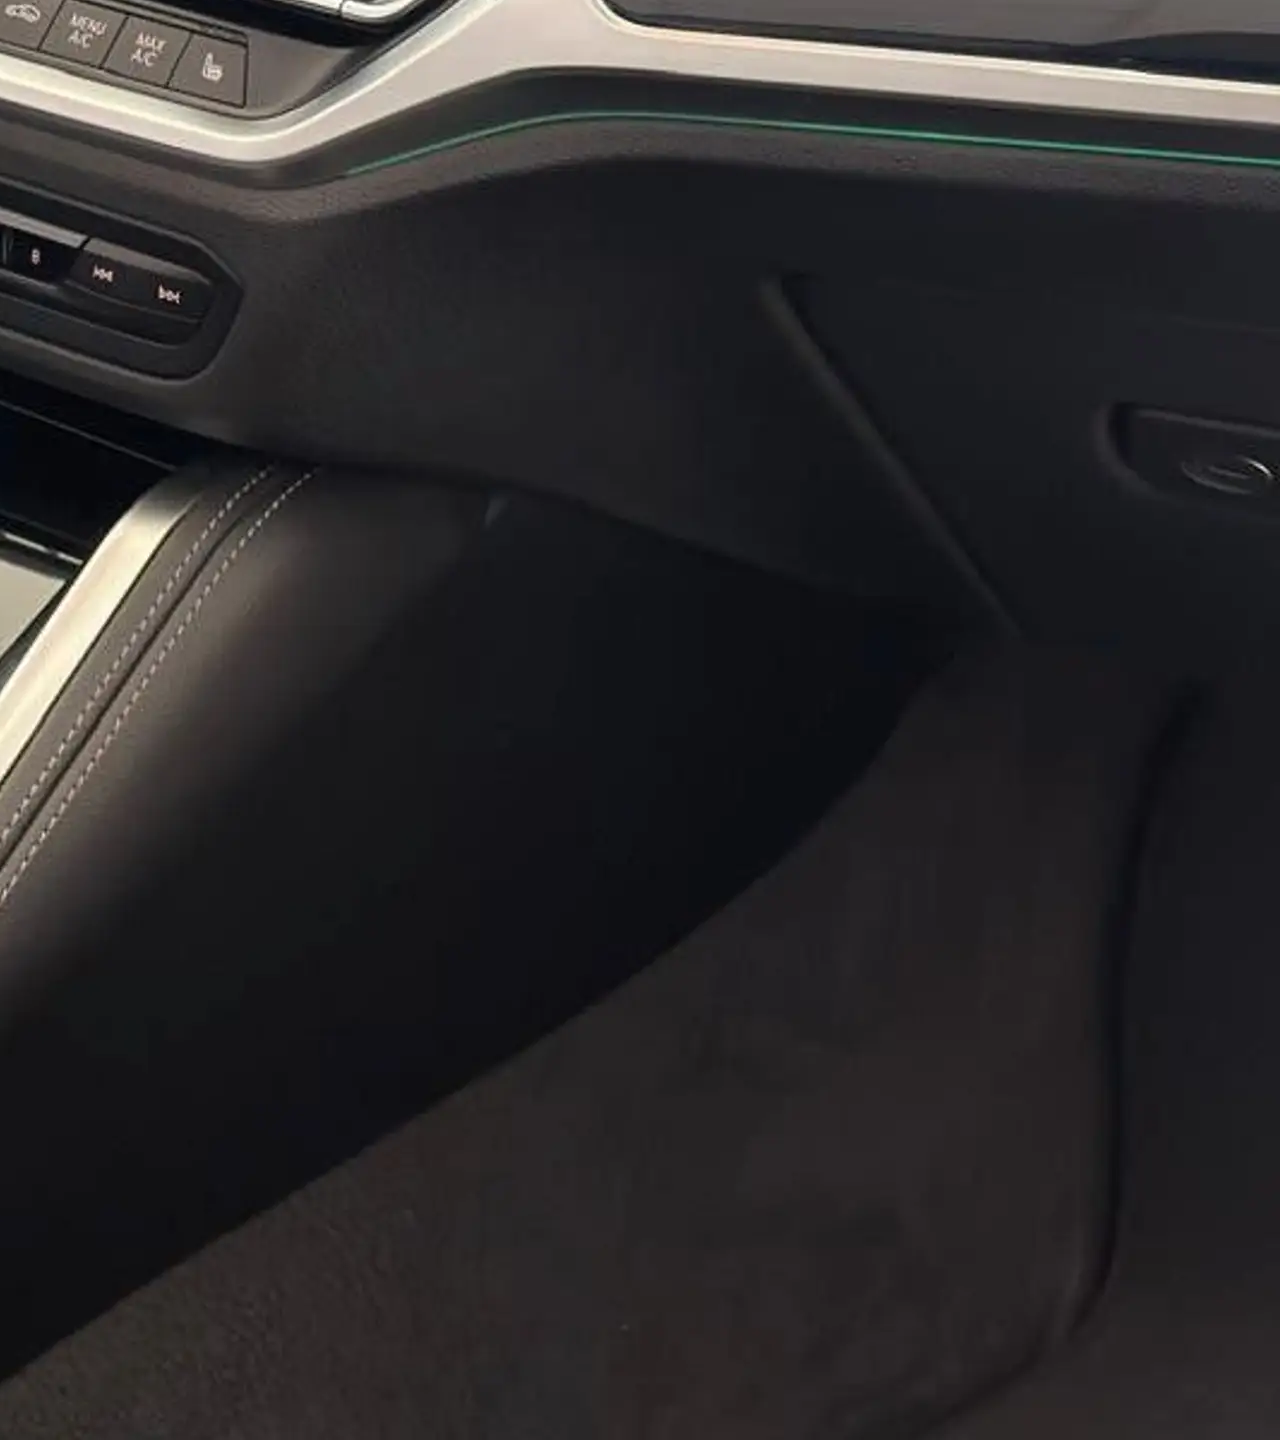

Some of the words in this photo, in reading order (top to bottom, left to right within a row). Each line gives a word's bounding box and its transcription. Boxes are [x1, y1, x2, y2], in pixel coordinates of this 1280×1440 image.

[69, 12, 108, 36] MENU
[67, 30, 95, 49] A/C
[130, 47, 158, 67] A/C
